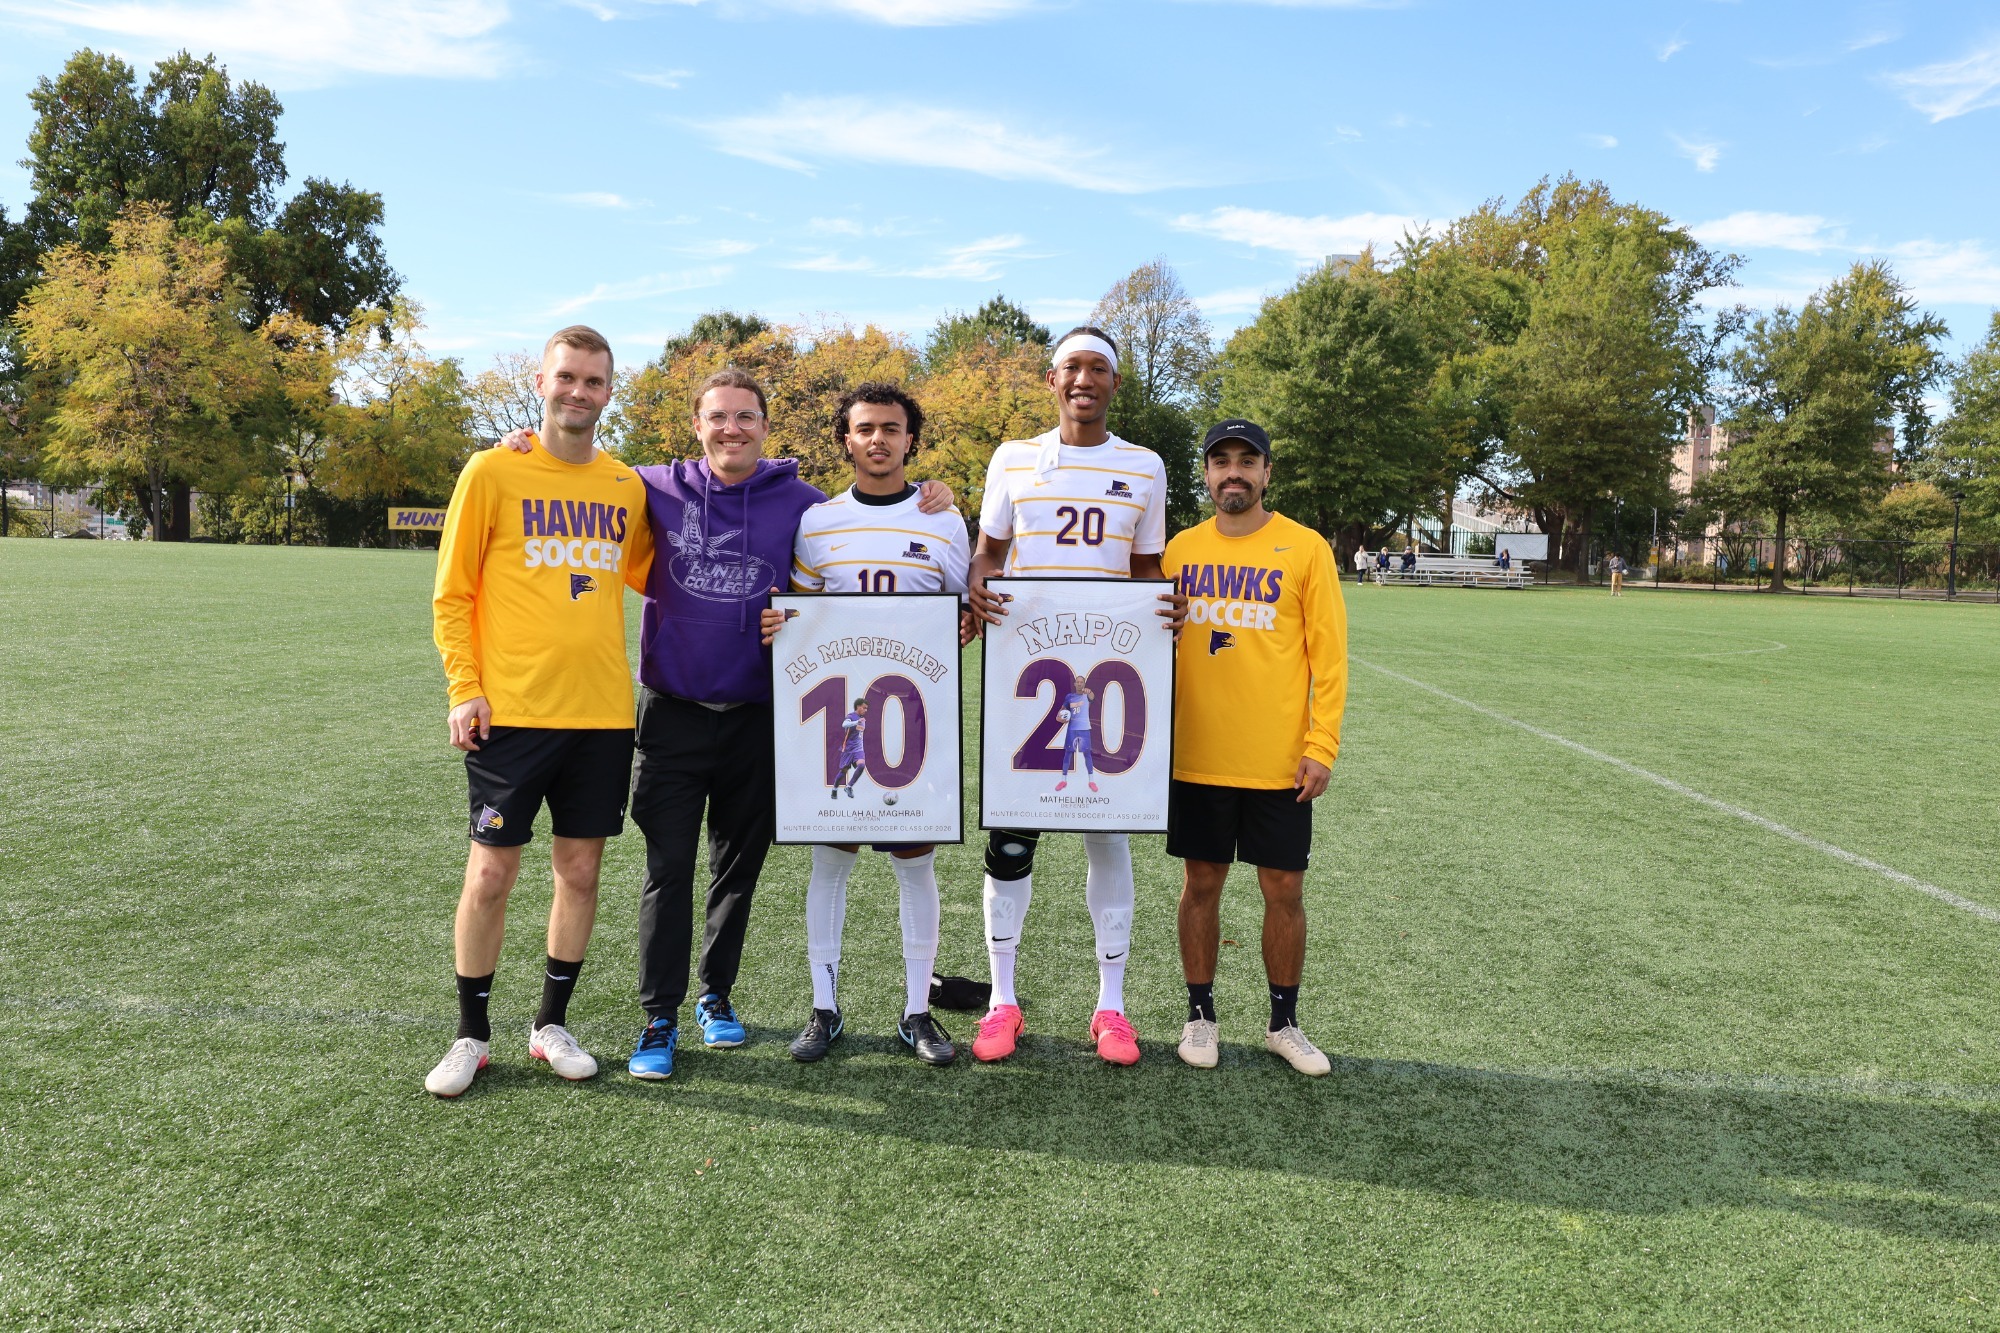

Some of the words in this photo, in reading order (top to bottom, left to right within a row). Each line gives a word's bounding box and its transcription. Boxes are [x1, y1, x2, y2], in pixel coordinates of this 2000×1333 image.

[1105, 489, 1133, 499] HUNTER
[522, 499, 628, 544] HAWKS
[1056, 506, 1107, 547] 20
[525, 539, 620, 573] SOCCER
[902, 550, 931, 562] HUNTER
[683, 575, 754, 595] COLLEGE
[688, 560, 761, 582] HUNTER
[858, 569, 898, 592] 10
[1181, 564, 1283, 604] HAWKS
[1017, 612, 1142, 656] NAPO
[784, 654, 818, 685] AL
[818, 636, 948, 684] MAGHRABI
[1011, 656, 1149, 776] 20
[800, 673, 929, 790] 10
[817, 809, 864, 818] ABDULLAH
[865, 809, 877, 818] AL
[878, 809, 924, 818] MAGHRABI
[1040, 795, 1084, 804] MATHELIN
[1085, 796, 1110, 805] NAPO
[1020, 810, 1053, 818] COLLEGE
[1054, 811, 1076, 819] MEN'S
